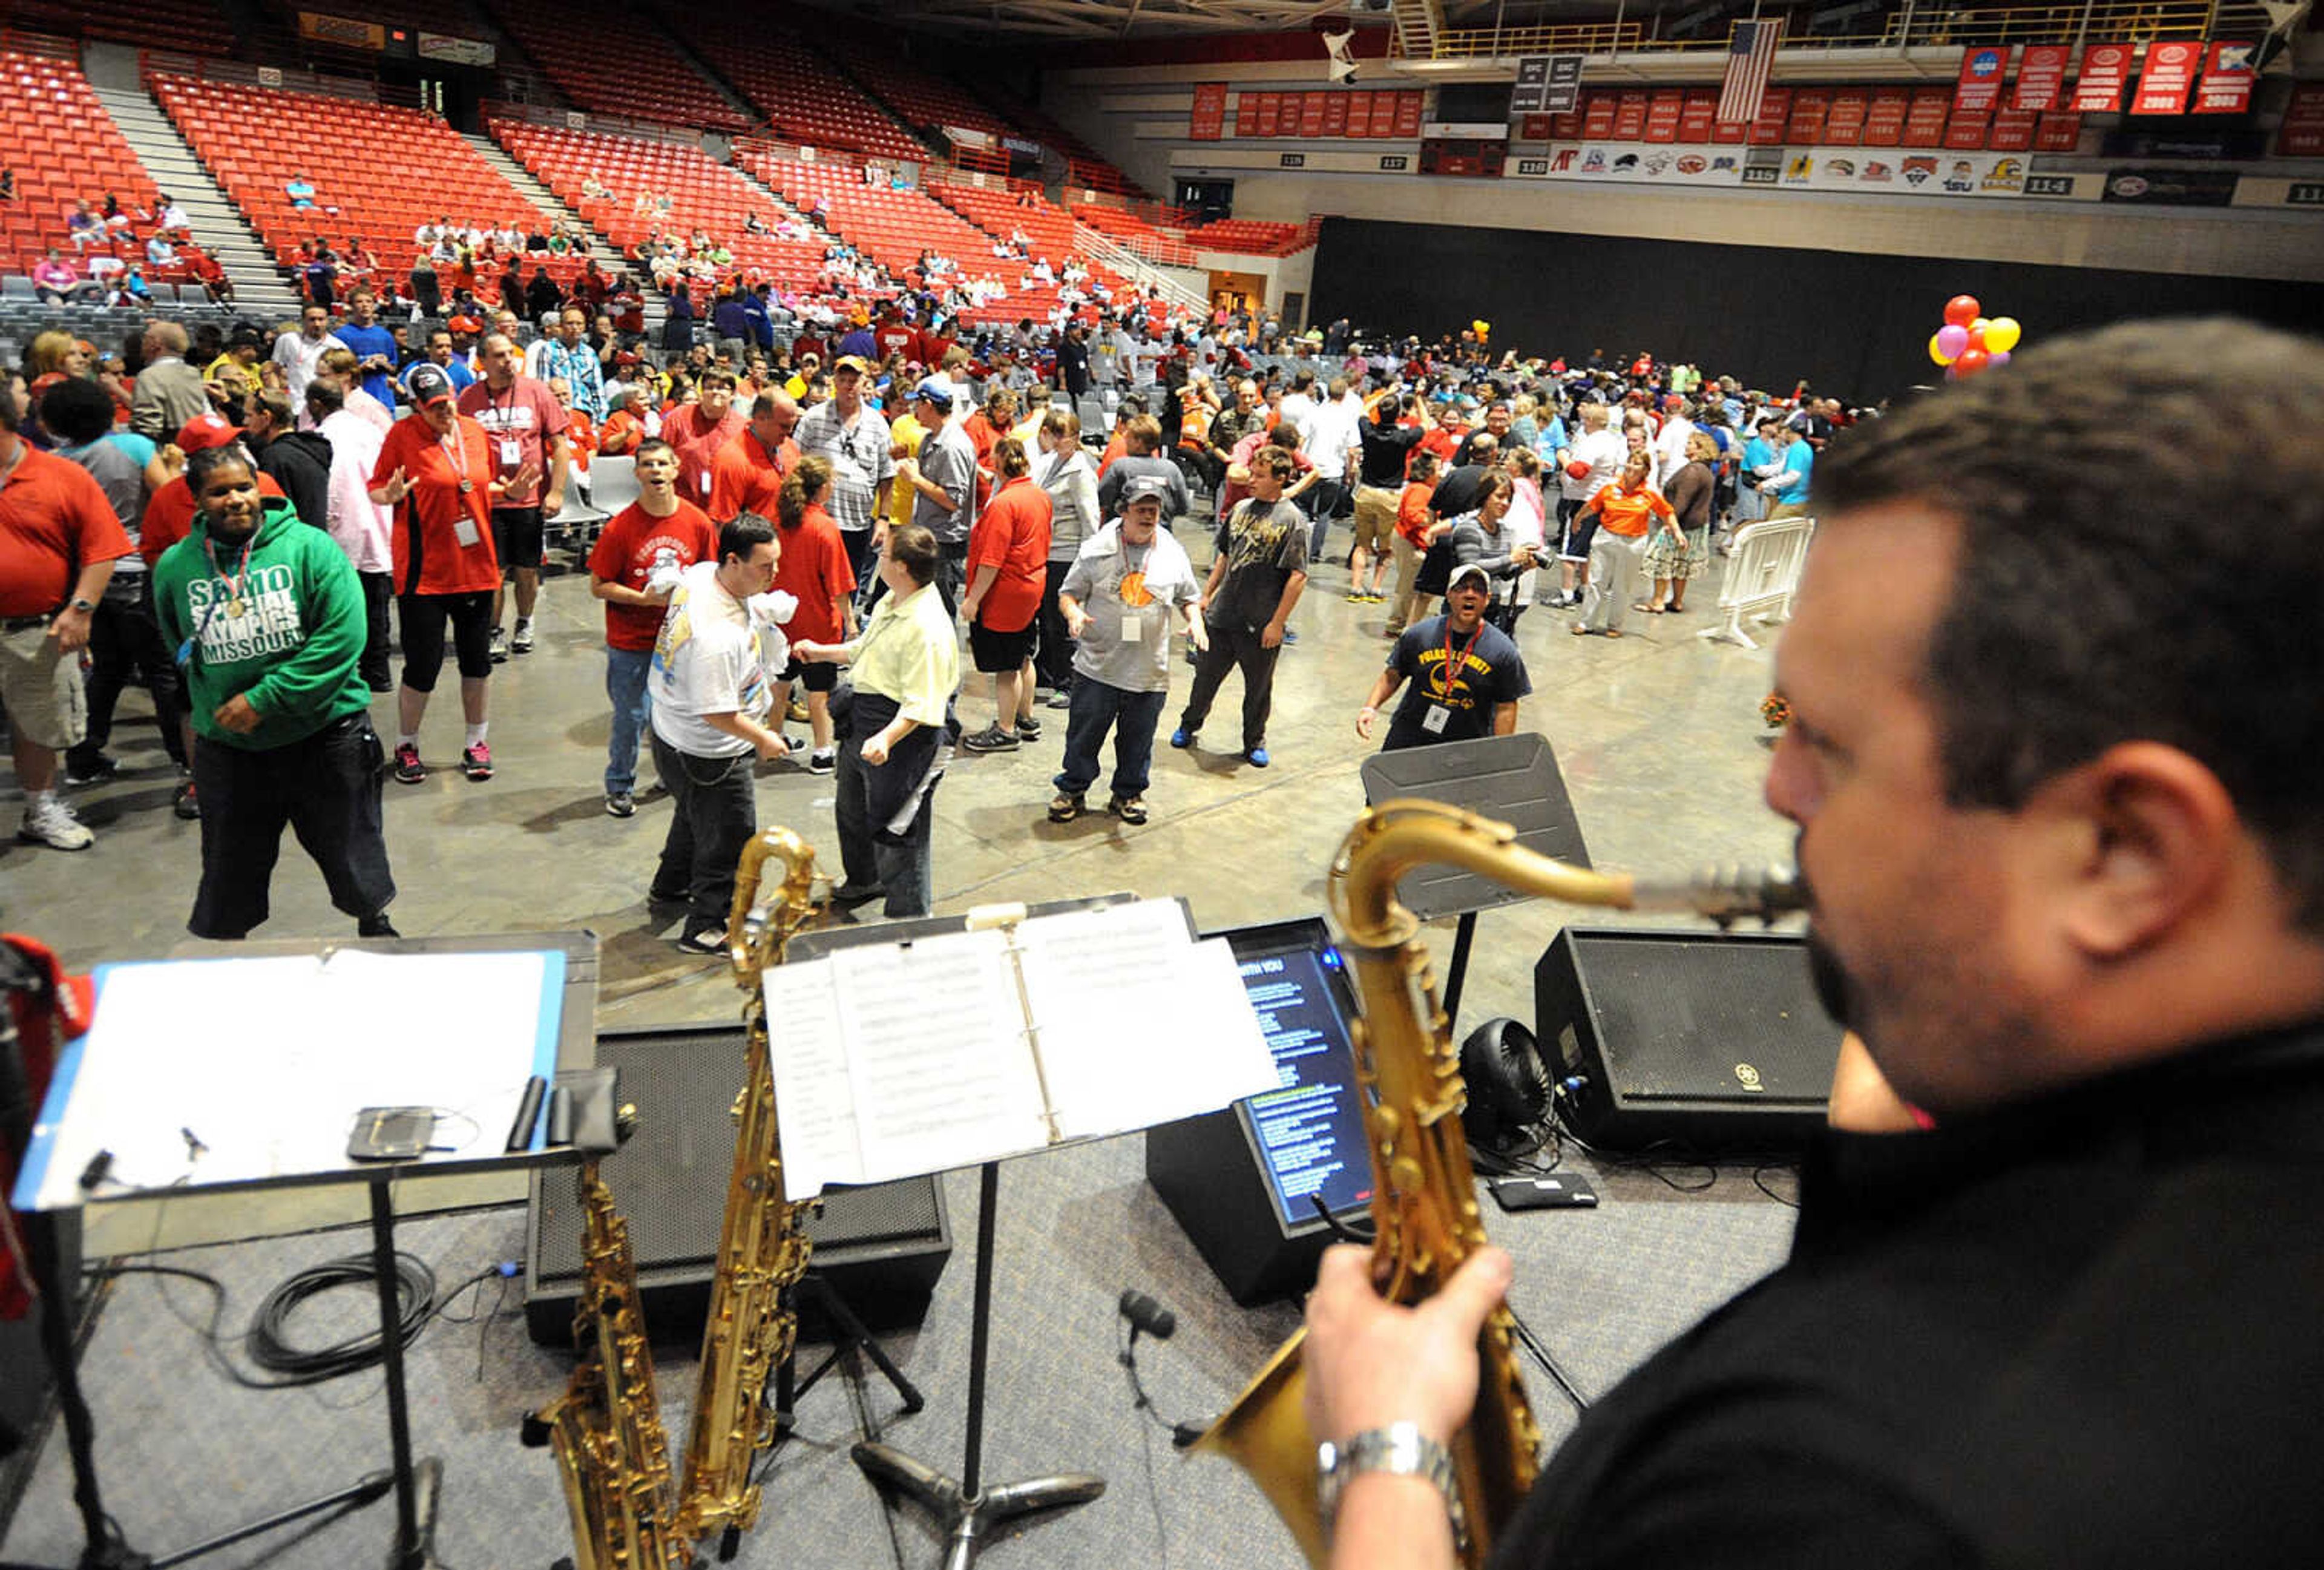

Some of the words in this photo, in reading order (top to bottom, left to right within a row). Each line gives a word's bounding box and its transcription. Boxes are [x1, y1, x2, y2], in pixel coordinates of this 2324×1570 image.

[189, 590, 297, 624] SPCIAL
[1418, 648, 1456, 665] PULASI
[1457, 651, 1492, 675] CUNTY
[1261, 959, 1284, 974] YOU
